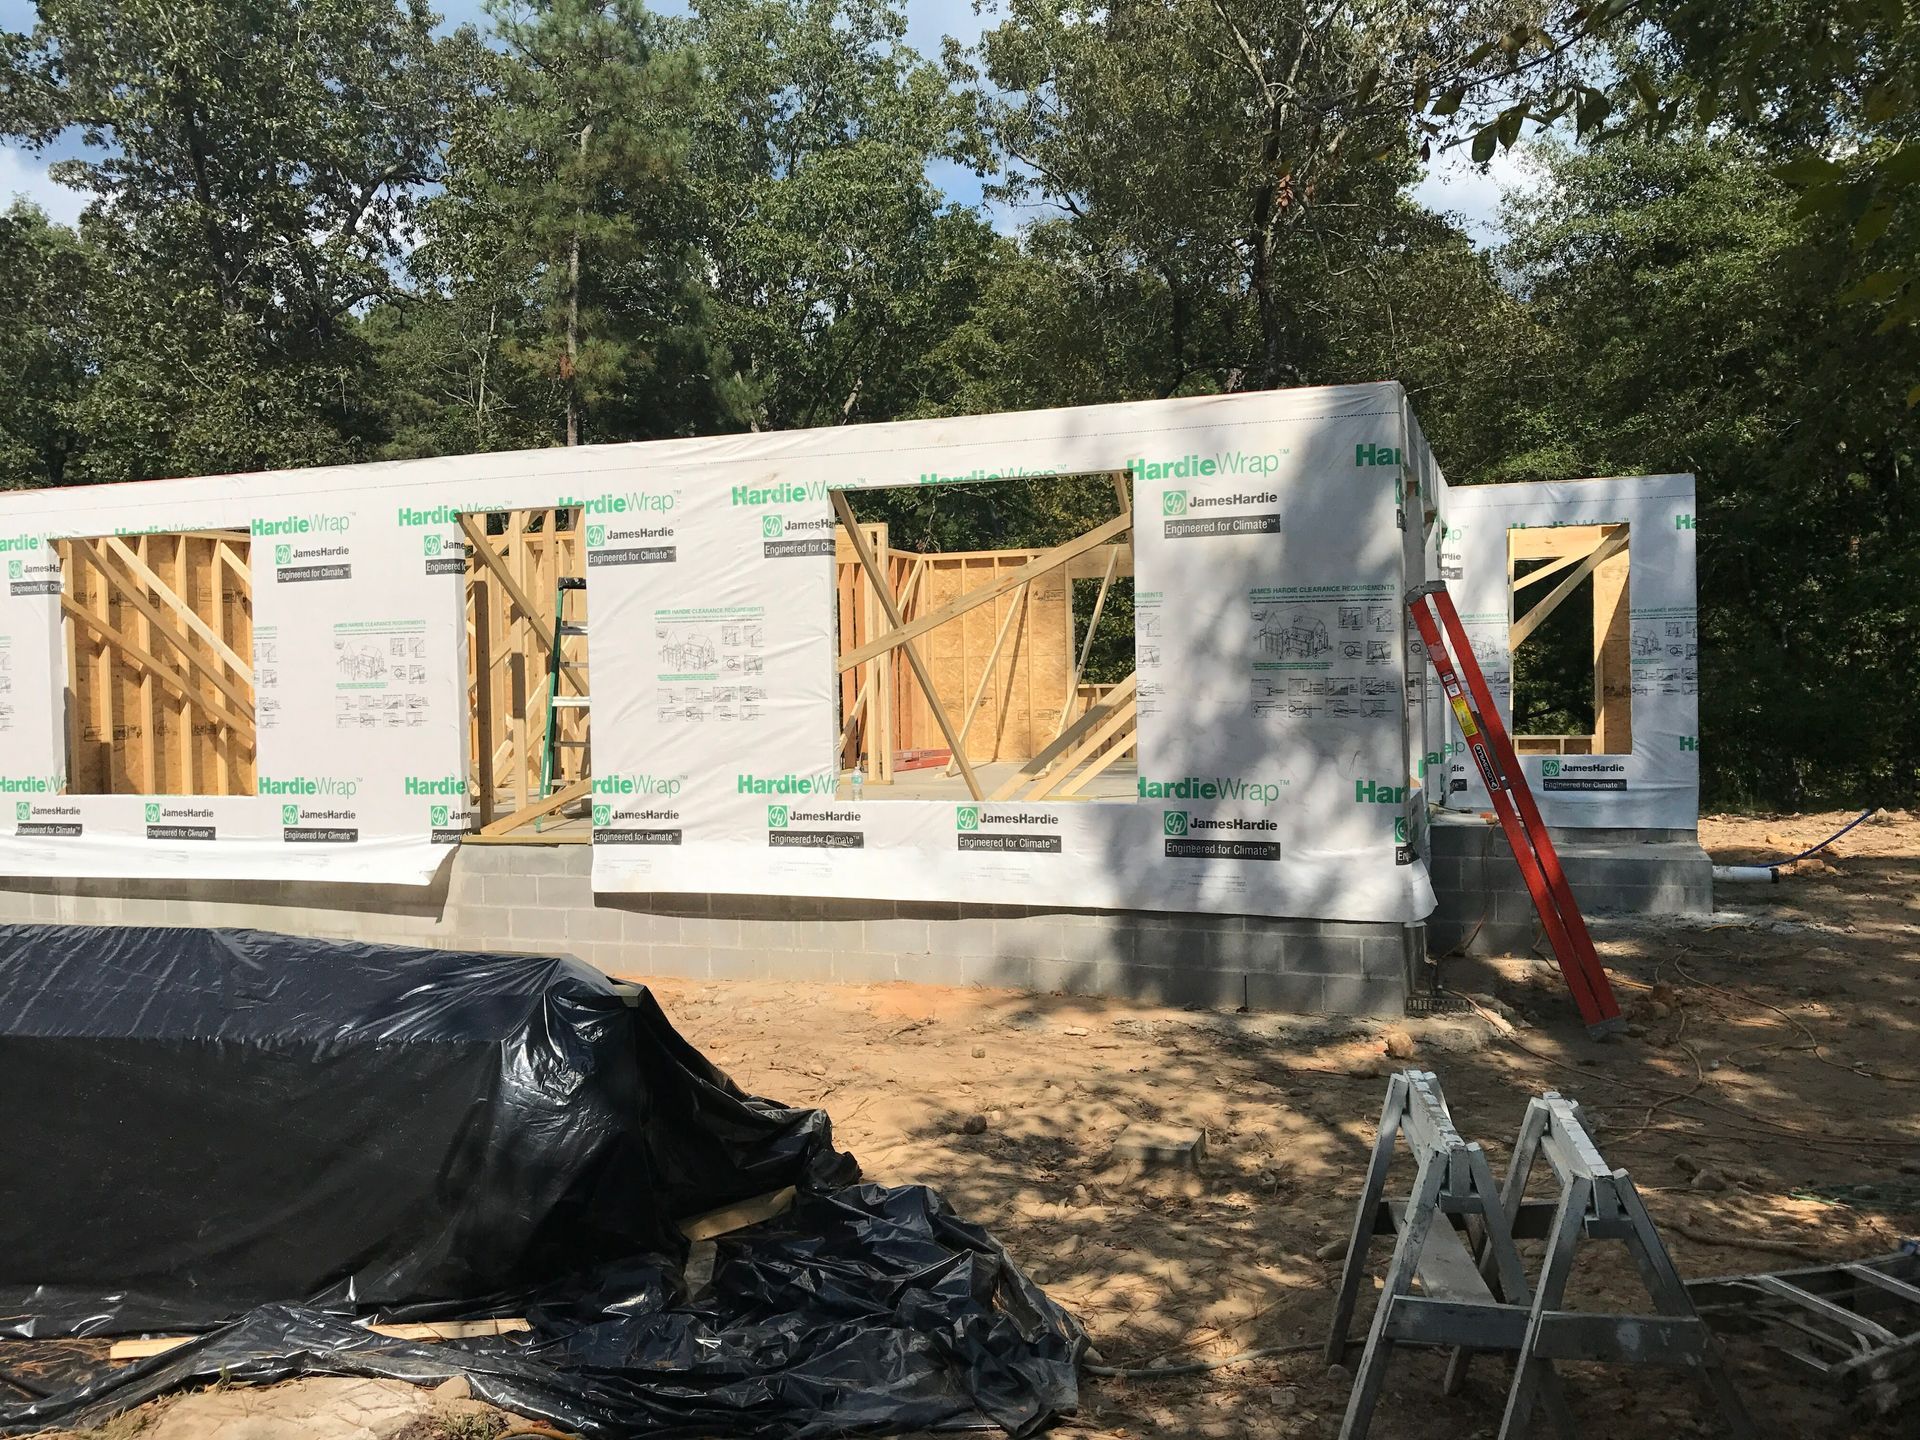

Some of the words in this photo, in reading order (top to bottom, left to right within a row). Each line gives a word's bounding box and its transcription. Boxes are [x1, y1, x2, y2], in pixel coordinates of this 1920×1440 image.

[1189, 492, 1278, 508] JamesHardie
[607, 527, 674, 540] JamesHardie
[1165, 520, 1215, 536] Engineered
[1217, 521, 1230, 531] for
[293, 546, 349, 559] JamesHardie
[1300, 585, 1341, 593] CLEARANCE
[1562, 764, 1625, 772] JamesHardie
[32, 806, 81, 815] JamesHardie
[162, 808, 214, 818] JamesHardie
[300, 810, 356, 819] JamesHardie
[612, 810, 679, 820] JamesHardie
[790, 811, 861, 821] JamesHardie
[980, 813, 1059, 824] JamesHardie
[1190, 818, 1278, 831] JamesHardie
[959, 837, 1003, 848] Engineered
[1005, 838, 1017, 848] for
[1166, 843, 1215, 854] Engineered
[1217, 844, 1231, 855] for
